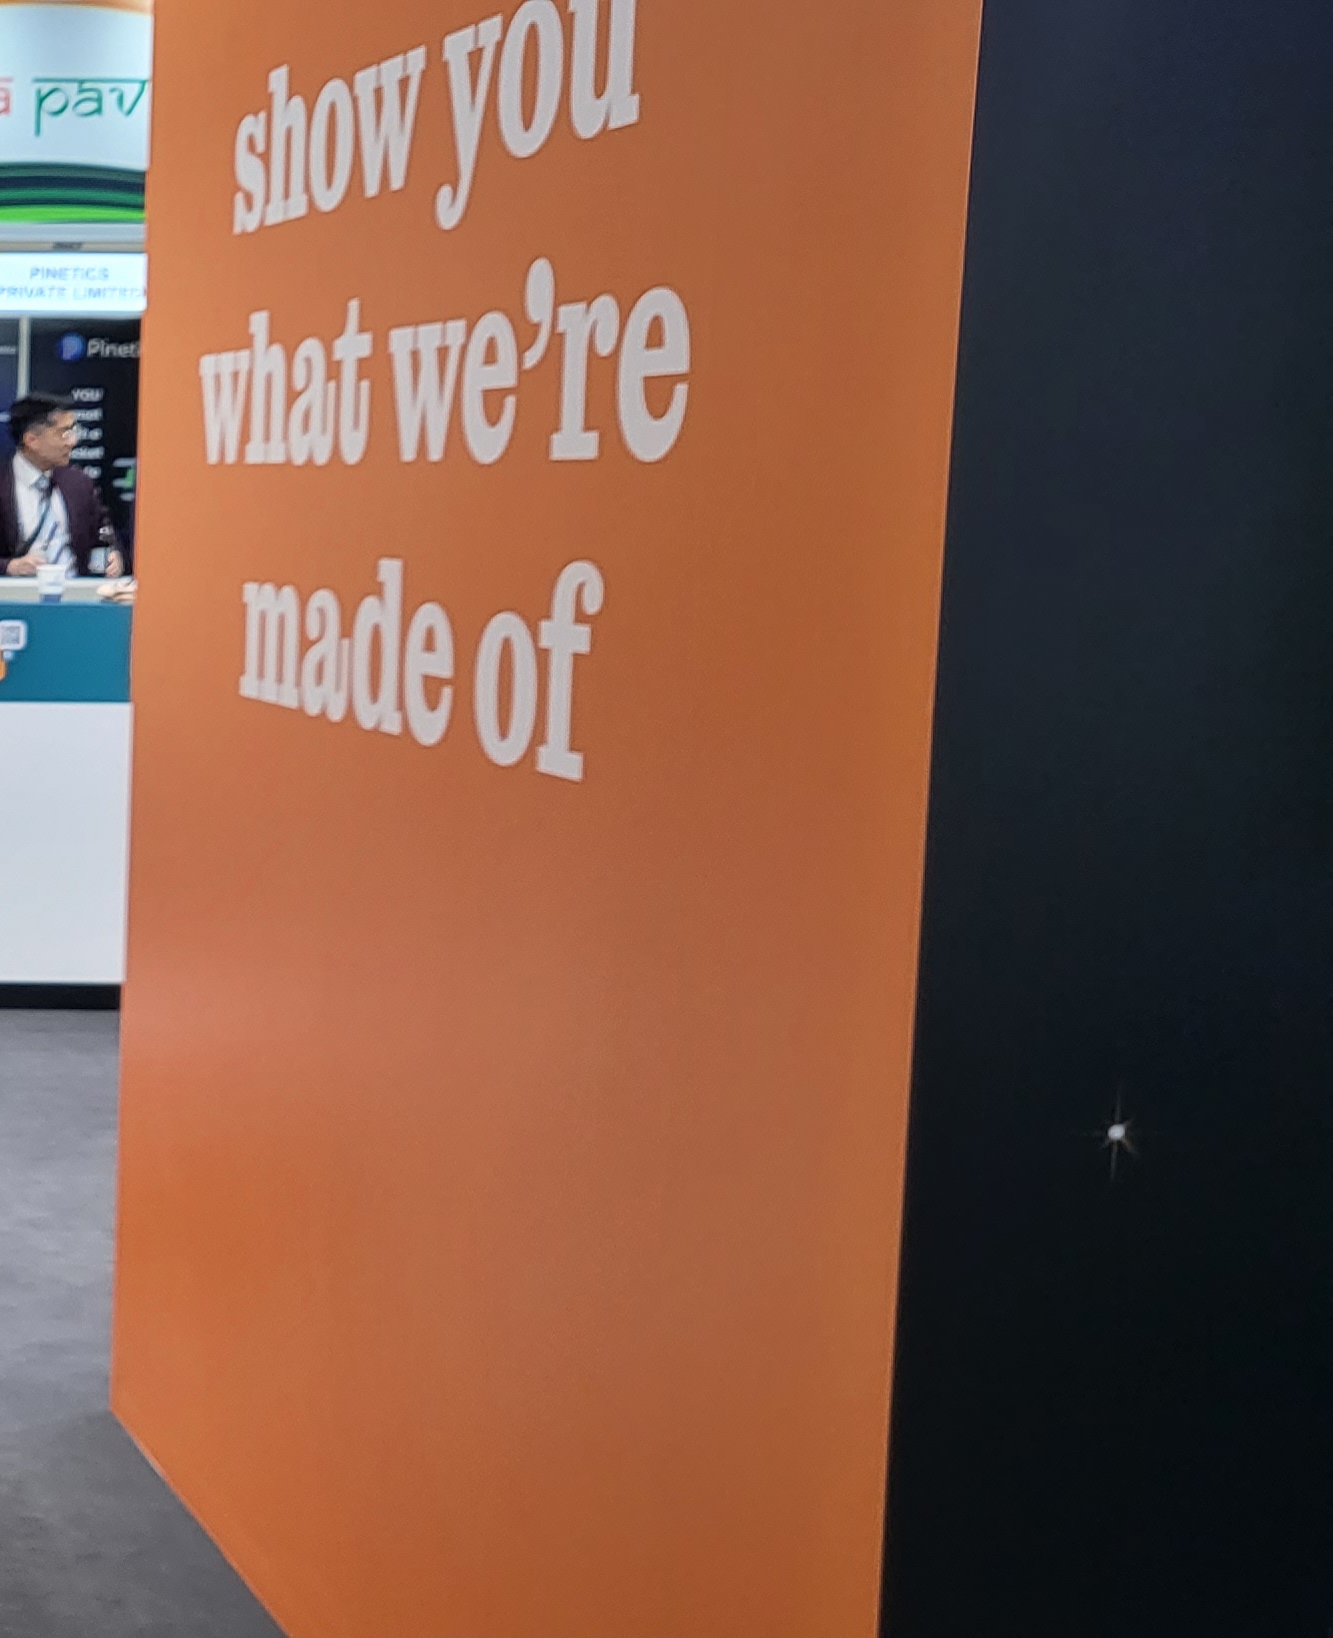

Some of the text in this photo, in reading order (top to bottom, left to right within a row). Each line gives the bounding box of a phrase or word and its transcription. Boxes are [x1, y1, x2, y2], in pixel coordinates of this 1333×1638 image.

[233, 0, 639, 234] show you
[200, 258, 691, 465] what we're
[239, 558, 605, 782] made of
